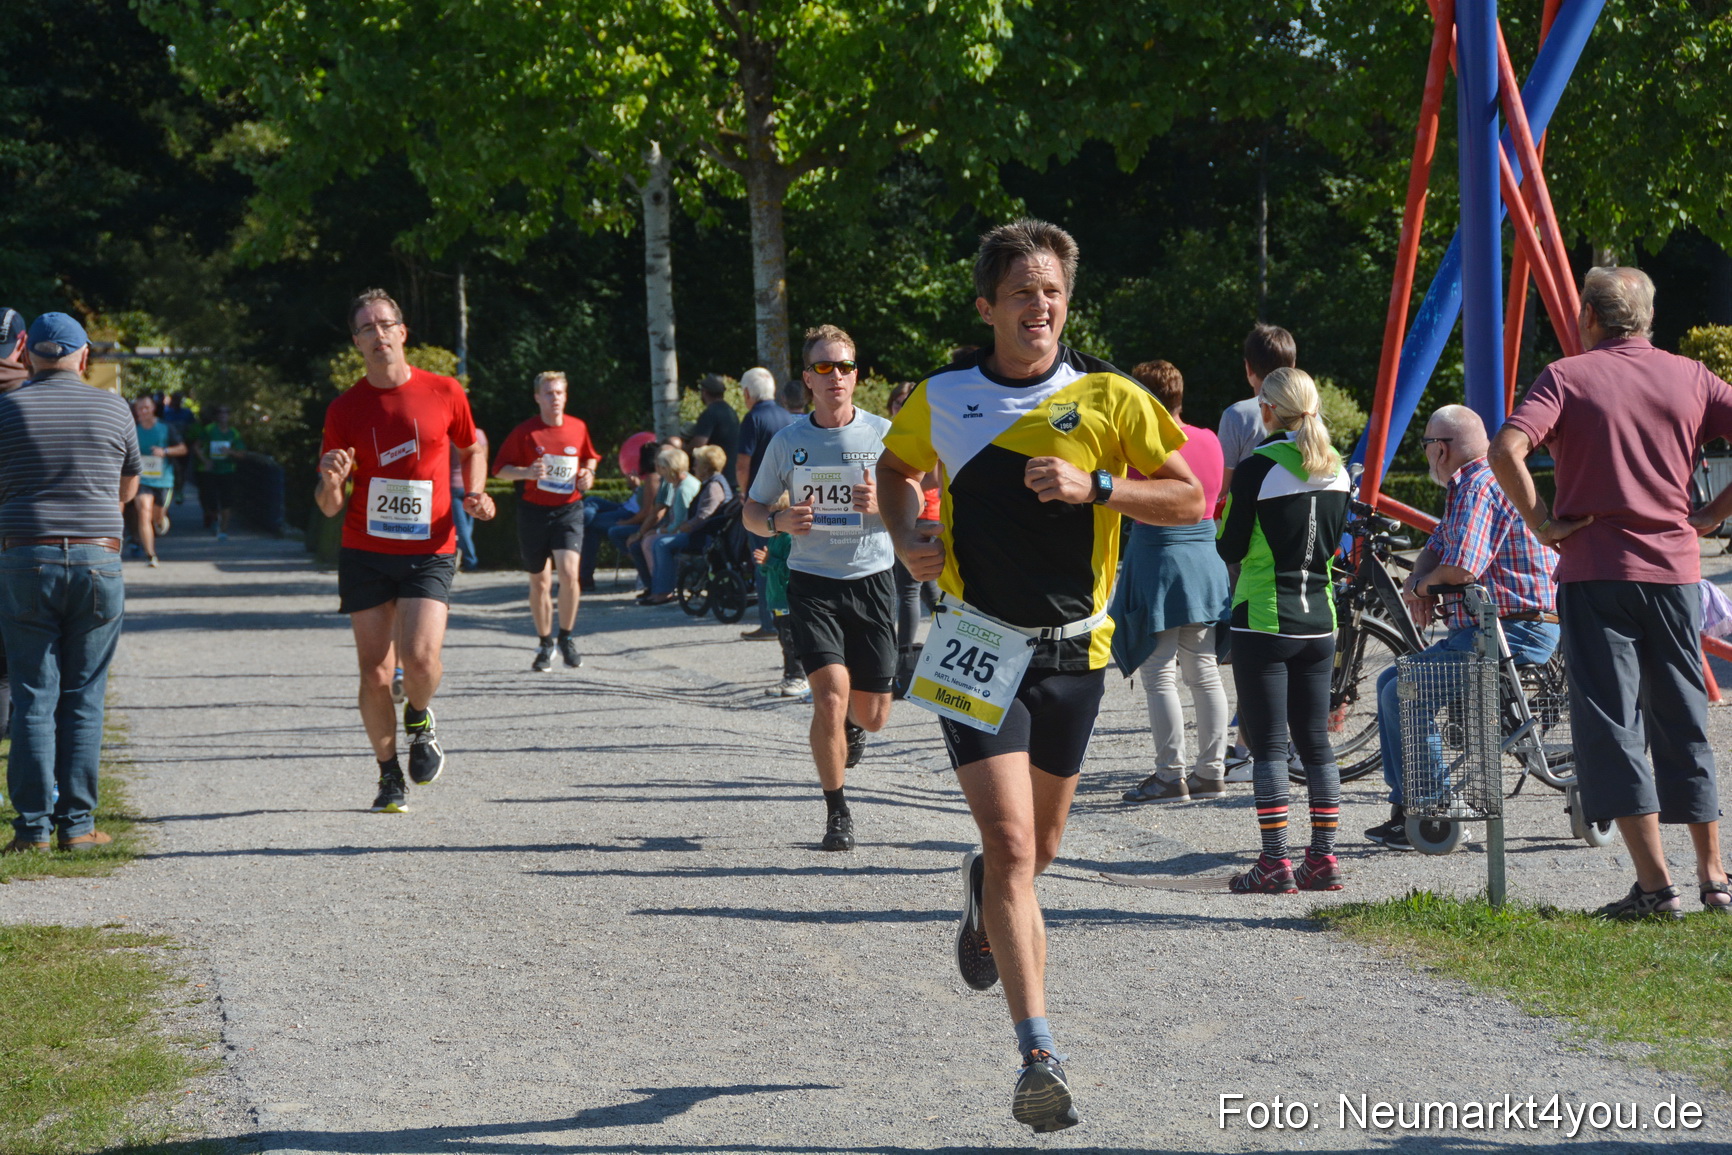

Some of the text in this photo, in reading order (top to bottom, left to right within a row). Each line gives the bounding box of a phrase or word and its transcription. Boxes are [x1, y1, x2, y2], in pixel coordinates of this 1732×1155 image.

[842, 452, 877, 460] BOCK
[546, 465, 572, 478] 2487
[377, 494, 422, 515] 2465
[803, 485, 851, 504] 2143
[382, 523, 415, 533] Berthold
[956, 620, 1003, 646] BOCK
[939, 638, 999, 684] 245
[934, 671, 981, 694] PARTL Neumarkt
[934, 687, 972, 712] Martin
